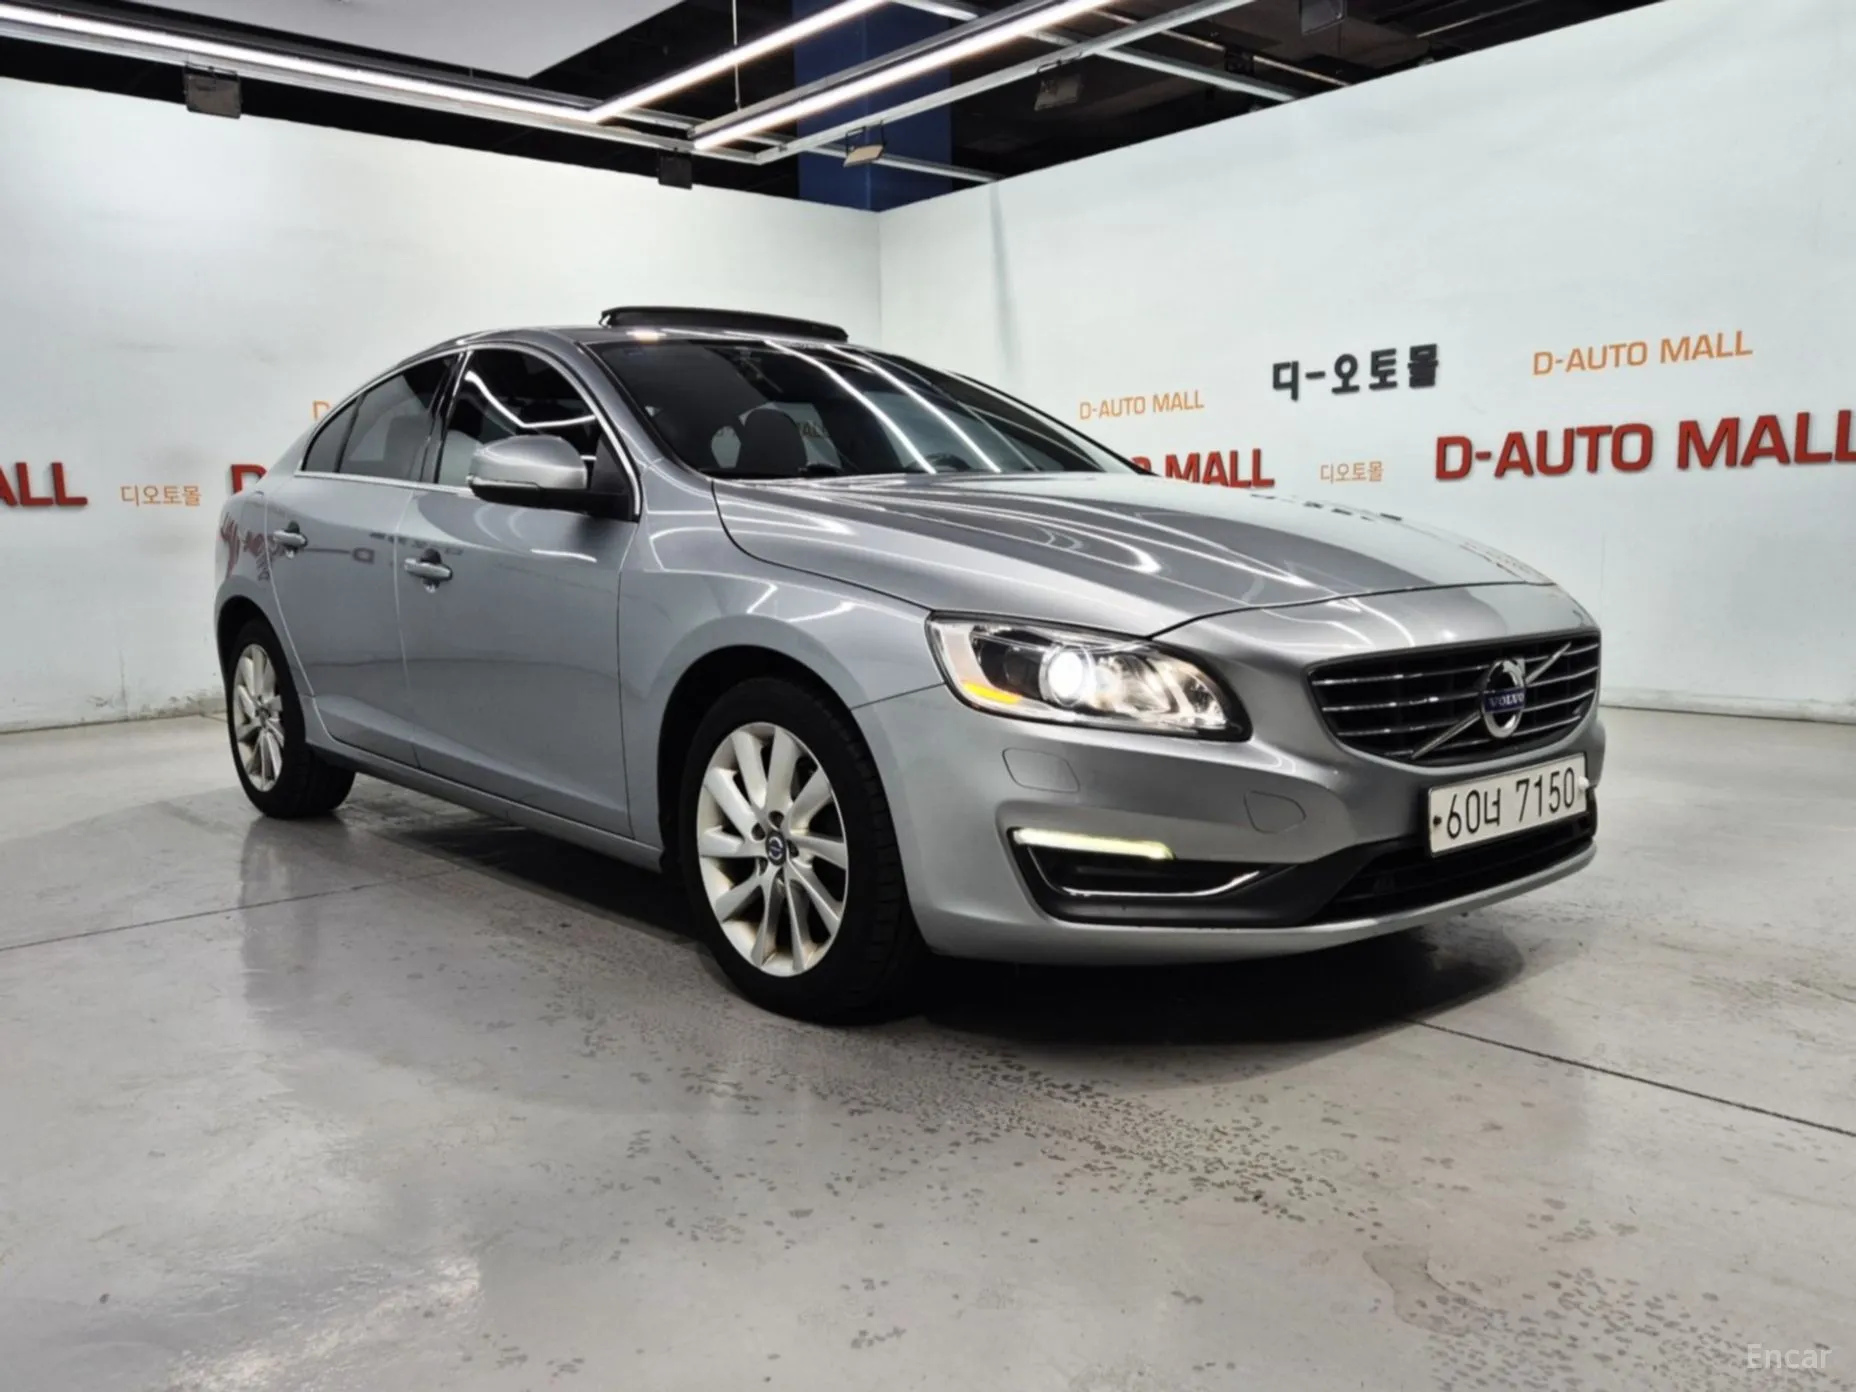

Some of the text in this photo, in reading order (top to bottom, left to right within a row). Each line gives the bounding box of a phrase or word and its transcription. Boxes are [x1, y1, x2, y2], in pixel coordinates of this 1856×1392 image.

[1272, 343, 1439, 402] 디-오토몰
[1533, 330, 1753, 375] D-AUTO MALL
[1079, 389, 1205, 420] D-AUTO MALL
[1435, 409, 1856, 481] D-AUTO MALL
[1164, 448, 1275, 488] MALL
[1319, 460, 1384, 484] 디오토몰
[120, 485, 201, 507] 디오토몰
[1446, 766, 1575, 839] 60너 7150
